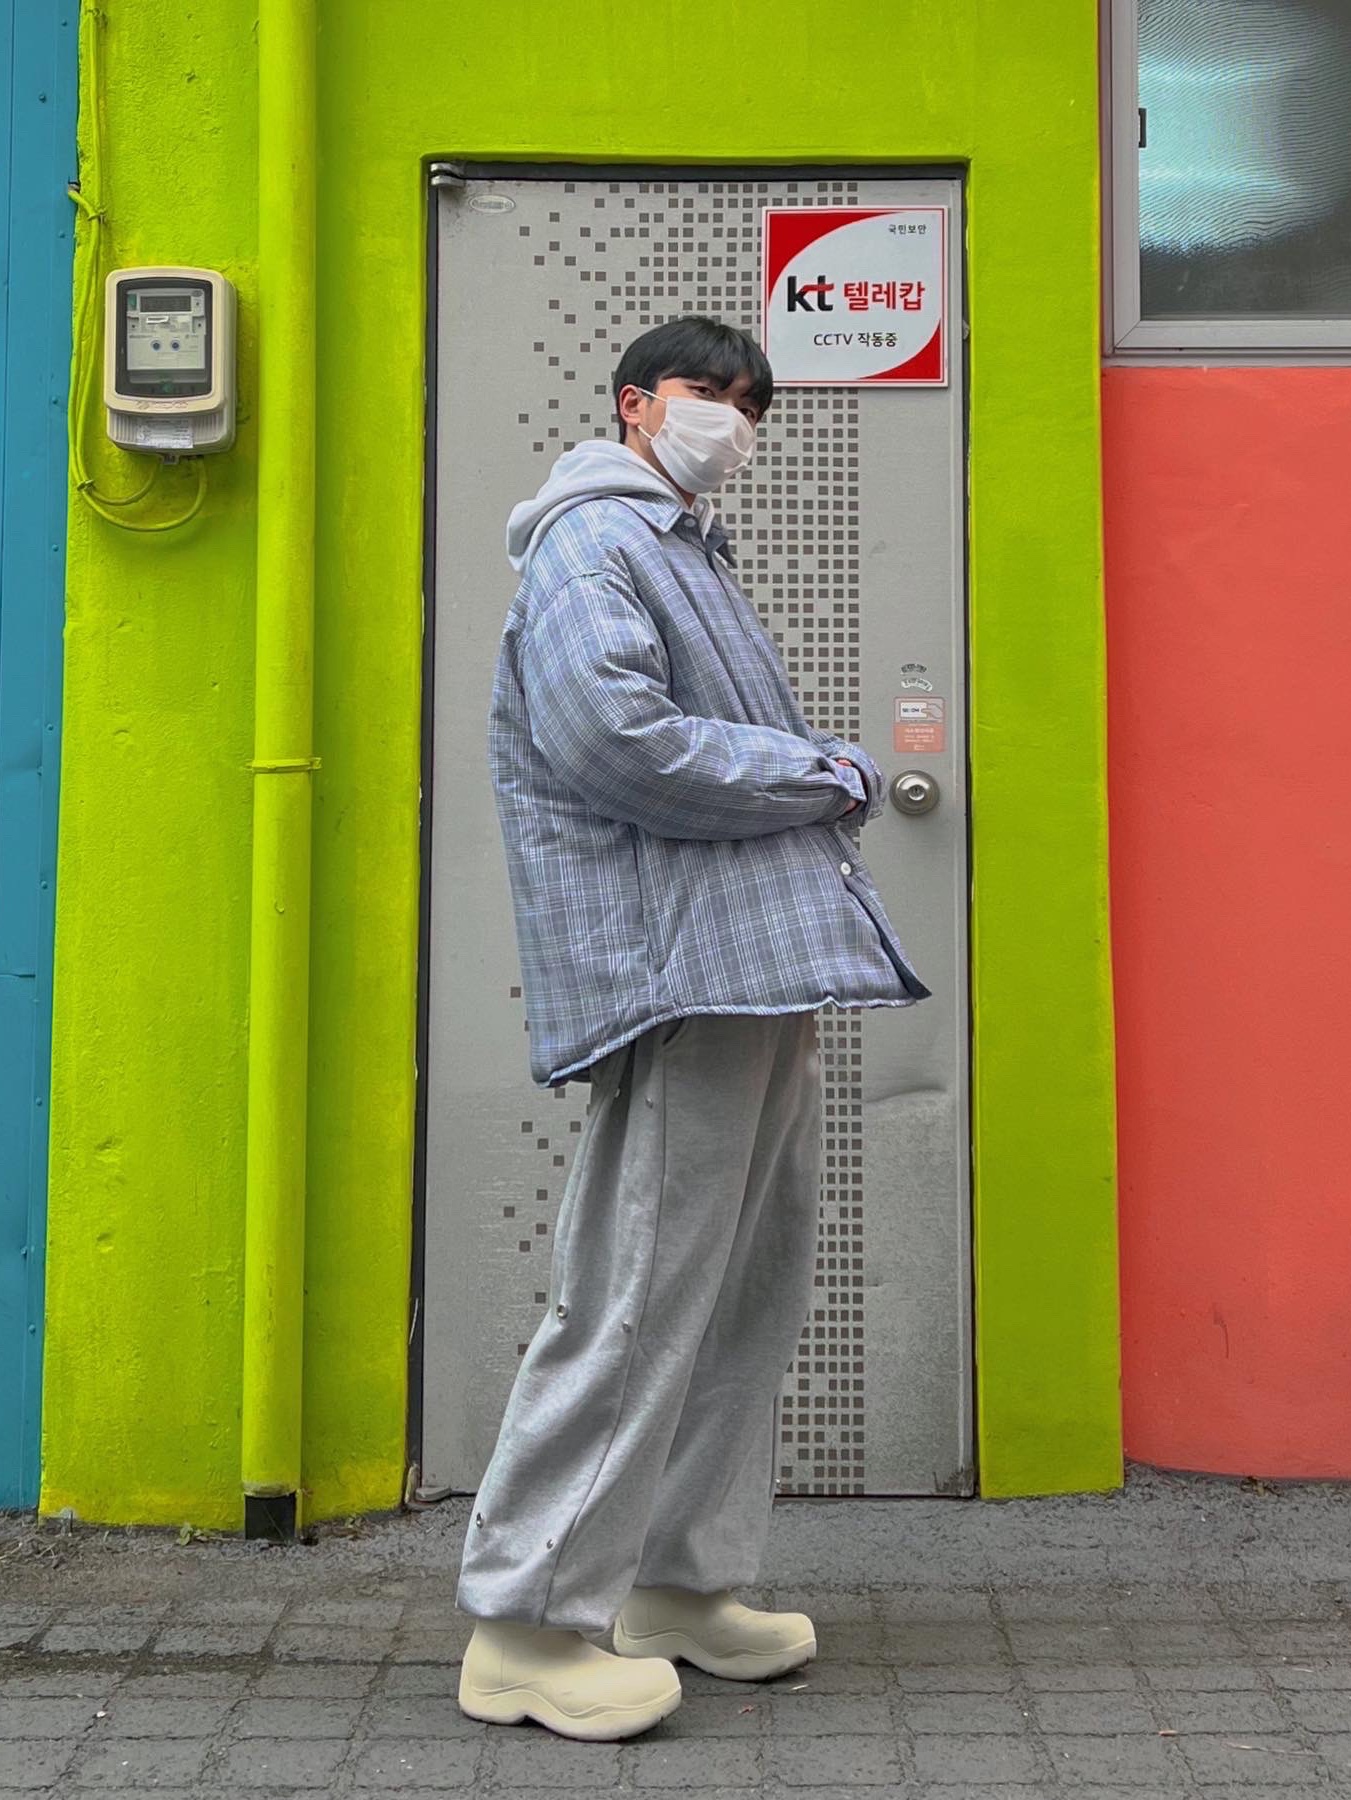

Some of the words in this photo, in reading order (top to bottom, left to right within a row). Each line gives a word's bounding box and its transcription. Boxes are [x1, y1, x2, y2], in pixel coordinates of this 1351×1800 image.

[888, 224, 927, 235] 국민보안
[787, 275, 835, 312] kt
[843, 281, 925, 311] 텔레캅
[813, 333, 853, 346] CCTV
[857, 332, 898, 347] 작동중
